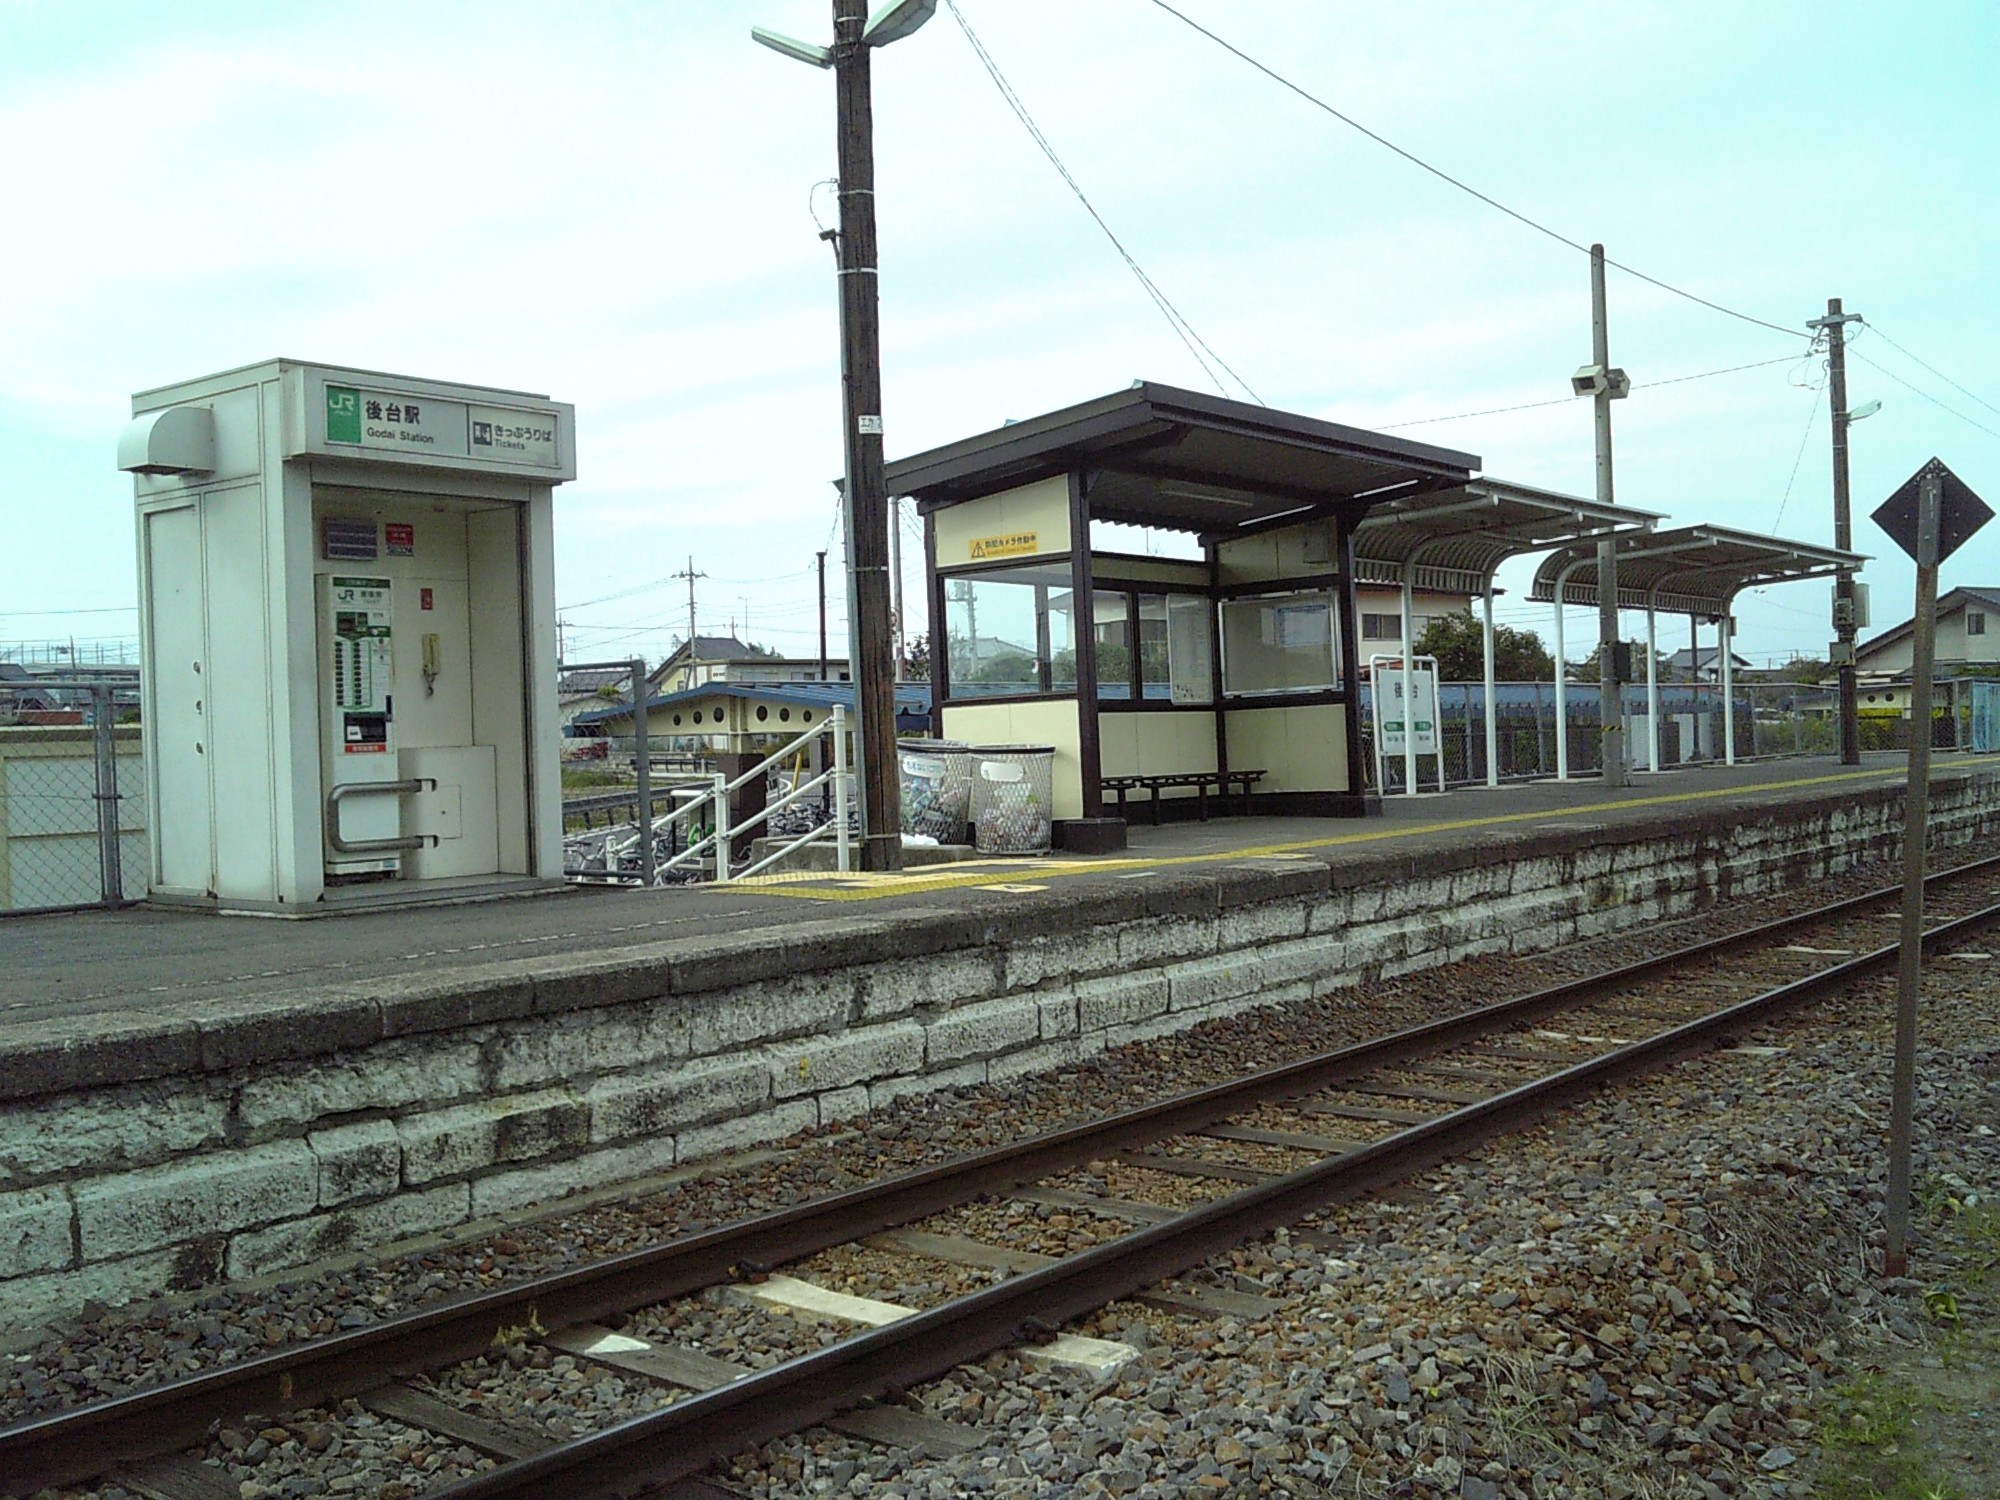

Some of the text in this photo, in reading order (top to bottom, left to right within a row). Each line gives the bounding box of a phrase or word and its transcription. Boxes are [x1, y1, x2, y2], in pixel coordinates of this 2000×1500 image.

[329, 394, 354, 411] JR
[366, 400, 420, 425] 後台駅
[367, 427, 434, 444] Godai Station
[494, 424, 553, 442] きっぷうりば
[495, 439, 526, 450] Tickets
[337, 589, 354, 601] JR
